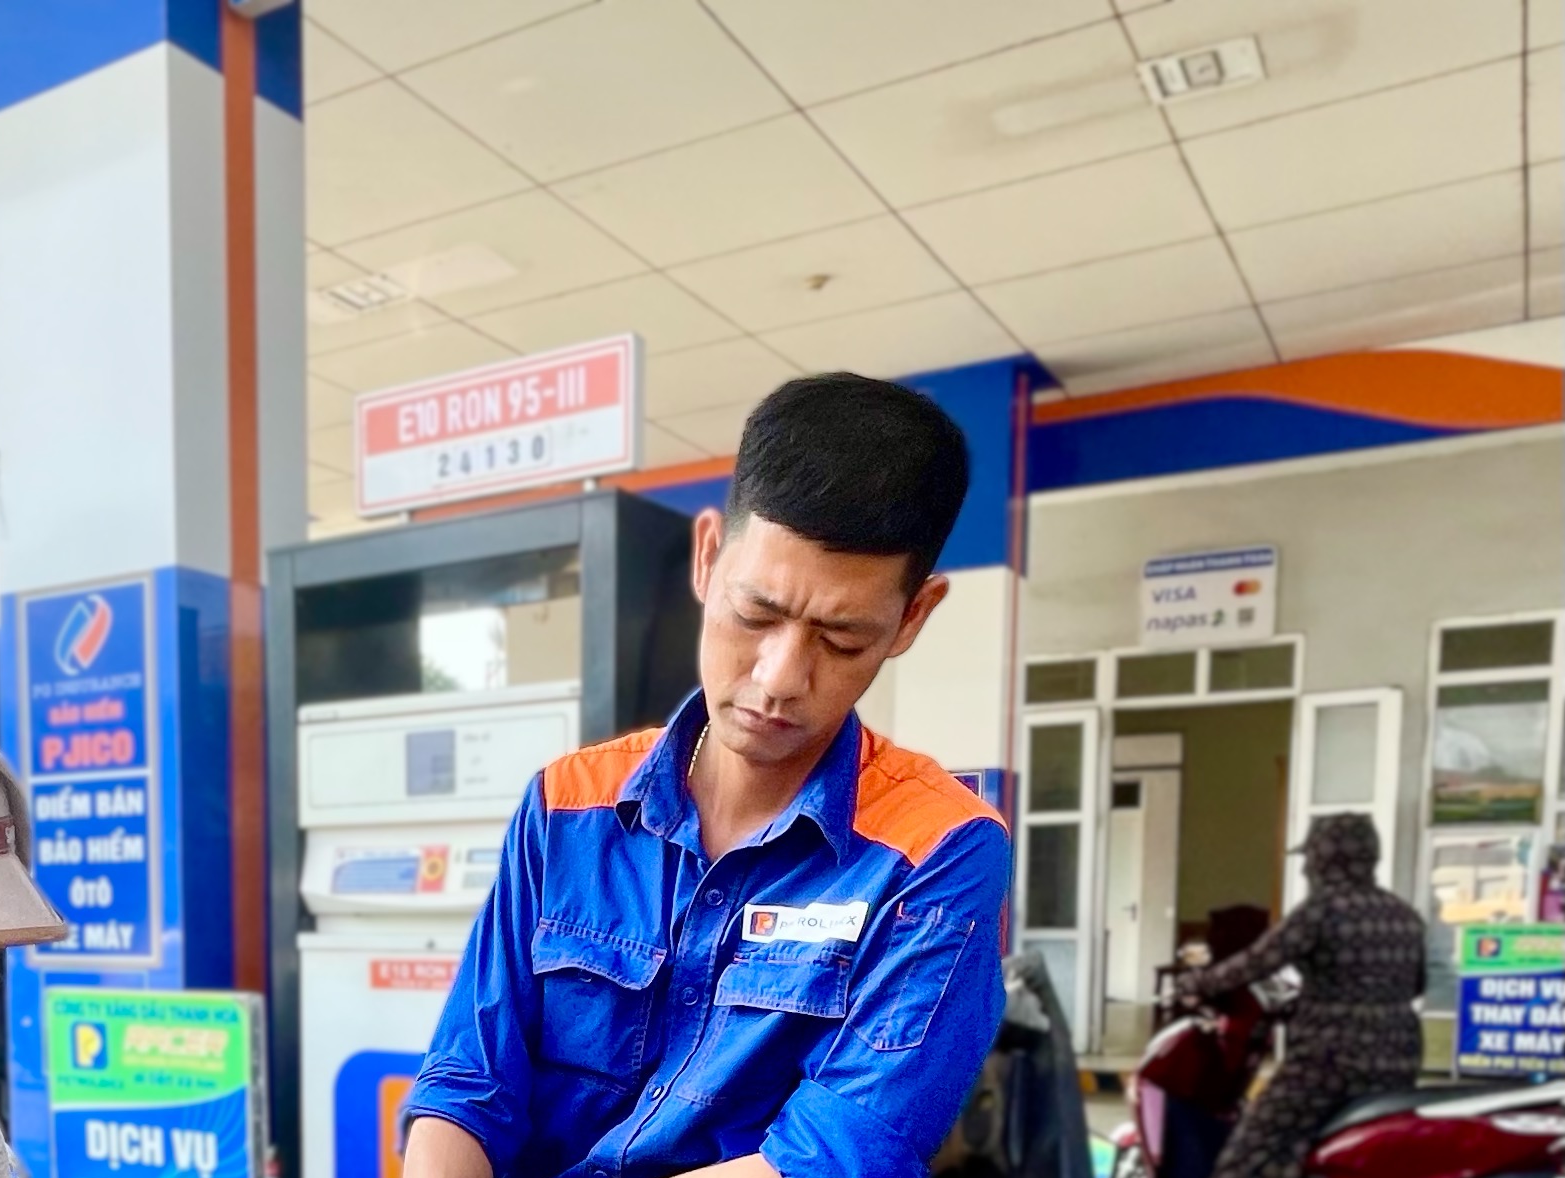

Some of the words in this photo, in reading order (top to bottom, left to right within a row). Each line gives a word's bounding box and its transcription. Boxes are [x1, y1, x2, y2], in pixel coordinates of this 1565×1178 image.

[398, 400, 439, 446] E10
[446, 385, 502, 432] RON
[508, 365, 586, 421] 95-III
[1152, 586, 1197, 603] VISA
[1146, 613, 1207, 634] napas
[41, 729, 136, 770] PJICO
[36, 785, 92, 821] ĐIỂM
[98, 786, 144, 818] BÁN
[39, 829, 82, 865] BẢO
[88, 828, 145, 863] HIỂM
[69, 876, 113, 909] ÔTÔ
[84, 917, 135, 950] MÁY
[1479, 977, 1535, 1001] DỊCH
[1470, 1002, 1526, 1025] THAY
[1530, 1002, 1565, 1028] DẦ
[1478, 1030, 1510, 1051] XE
[85, 1120, 164, 1170] DỊCH
